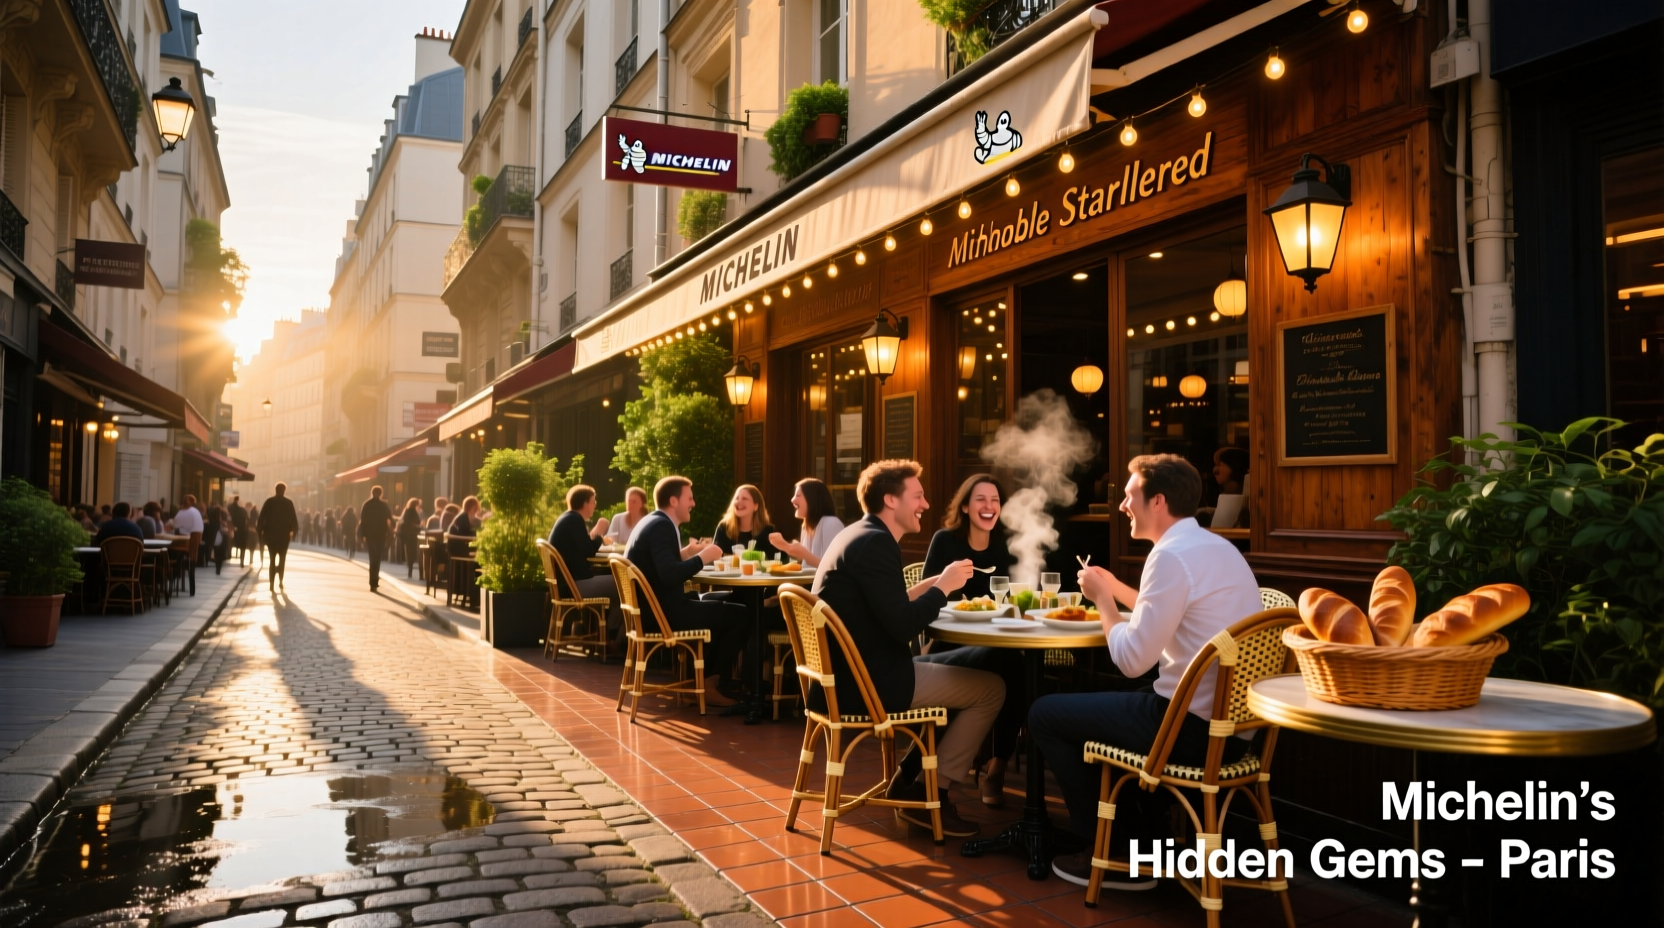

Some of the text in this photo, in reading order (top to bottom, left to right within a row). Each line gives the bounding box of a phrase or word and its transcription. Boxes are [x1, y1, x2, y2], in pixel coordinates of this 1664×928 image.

[650, 152, 732, 172] MICHELIN
[1059, 131, 1212, 227] Starllered
[699, 224, 800, 305] MICHELIN
